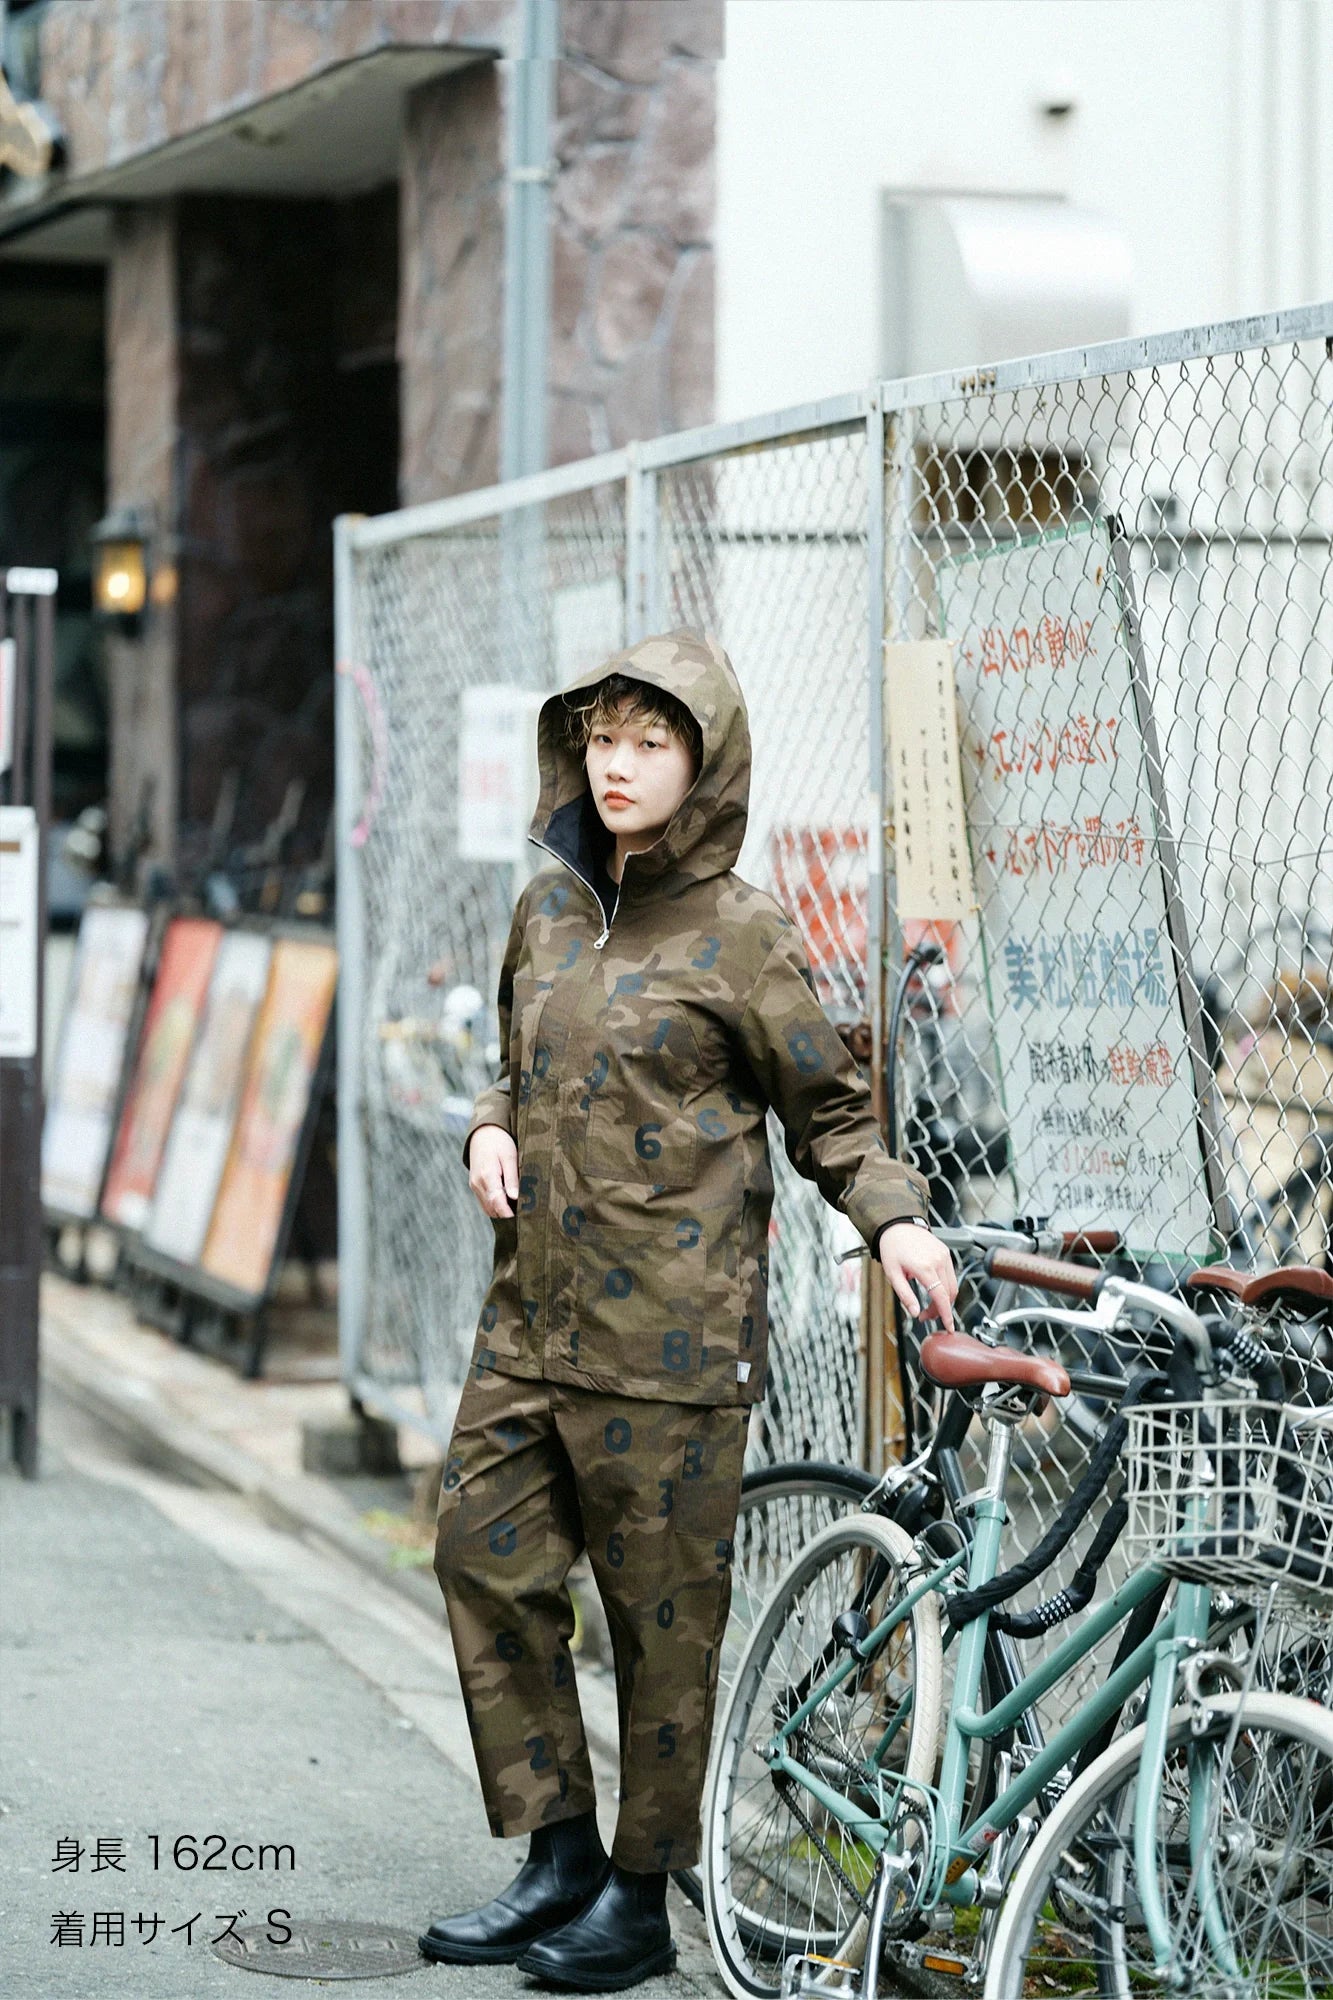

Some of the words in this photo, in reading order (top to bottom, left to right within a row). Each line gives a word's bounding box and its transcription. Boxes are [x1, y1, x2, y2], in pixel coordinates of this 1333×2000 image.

[691, 936, 721, 970] 3
[787, 1031, 824, 1074] 8
[635, 1122, 663, 1160] 6
[519, 1175, 538, 1212] 5
[604, 1267, 633, 1300] 0
[481, 1303, 498, 1333] 0
[661, 1329, 691, 1372] 8
[604, 1417, 632, 1454] 0
[442, 1457, 464, 1492] 6
[657, 1478, 674, 1518] 3
[488, 1520, 517, 1557] 0
[606, 1532, 625, 1569] 6
[657, 1599, 674, 1630] 0
[495, 1631, 524, 1663] 6
[525, 1736, 552, 1771] 2
[657, 1723, 676, 1759] 5
